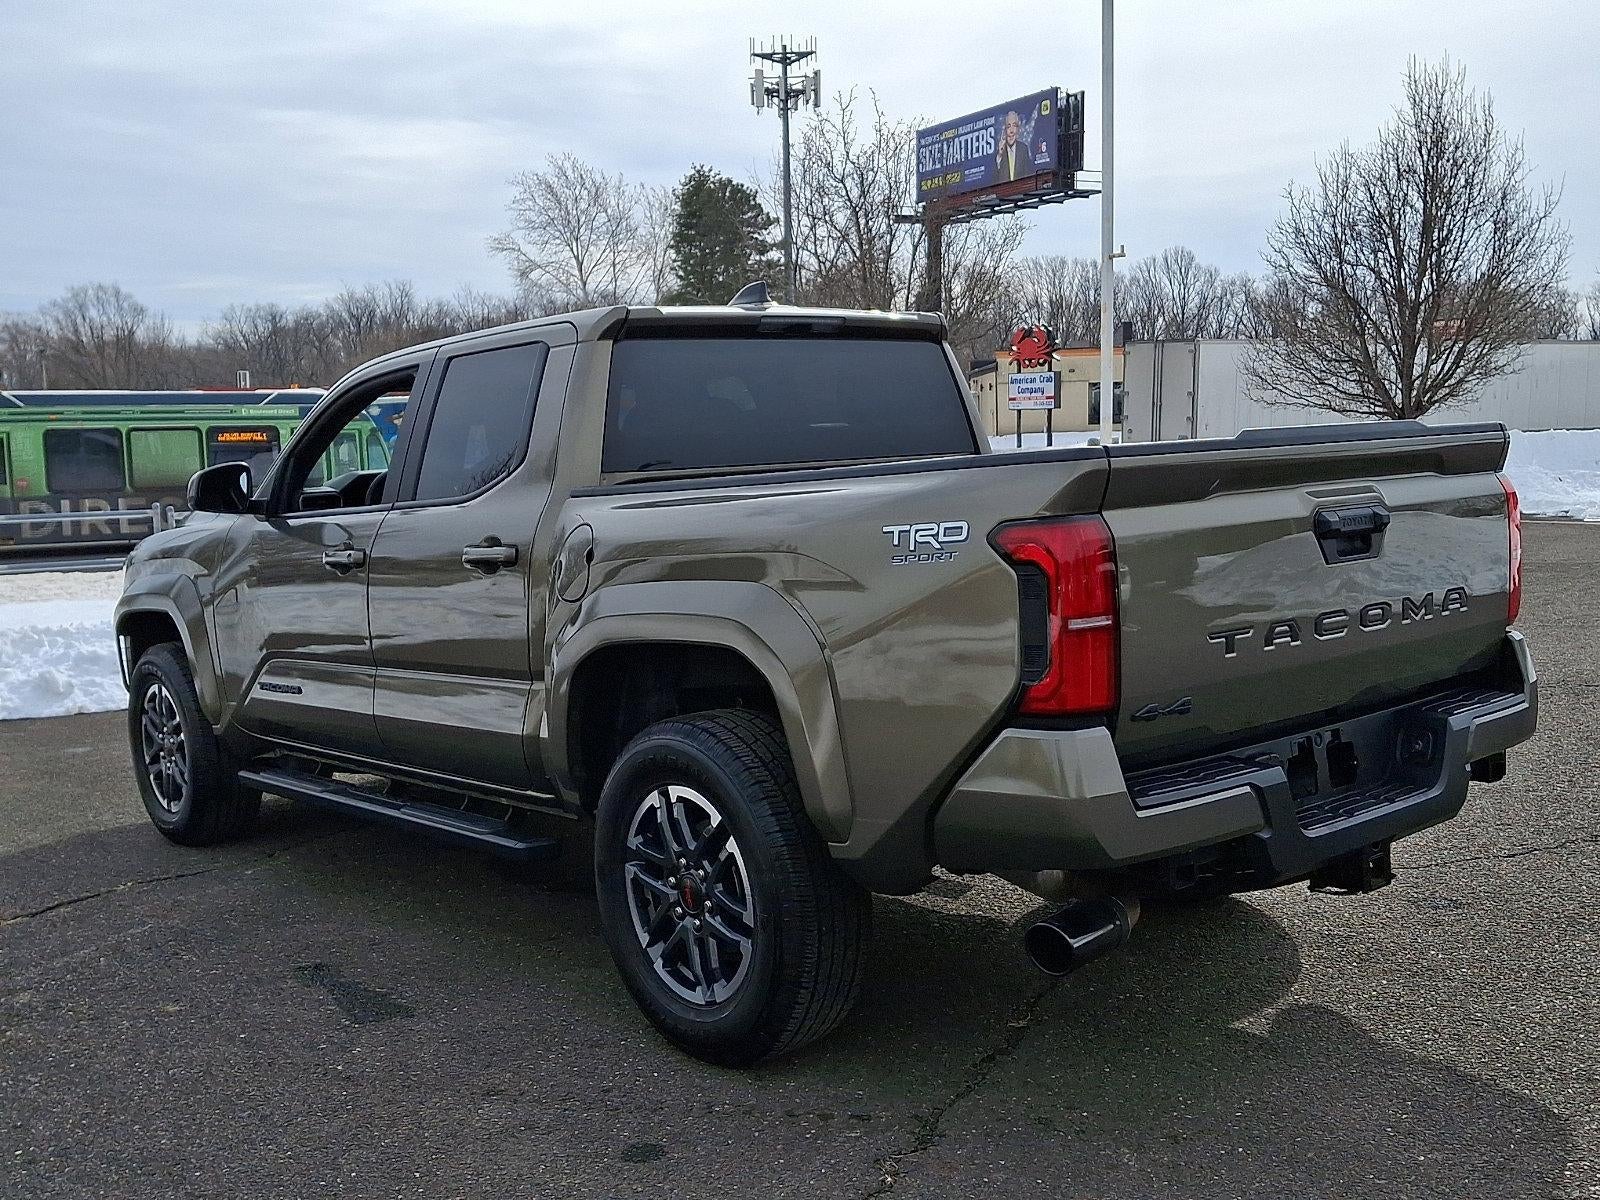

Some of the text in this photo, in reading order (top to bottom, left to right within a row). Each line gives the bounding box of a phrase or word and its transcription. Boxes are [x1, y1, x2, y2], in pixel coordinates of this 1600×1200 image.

[919, 126, 995, 173] SIZE MATTERS
[1010, 374, 1053, 385] American Crab
[1017, 386, 1045, 395] Company
[1341, 512, 1374, 528] TOYOTA
[882, 520, 970, 552] TRD
[891, 551, 959, 565] SPORT
[1206, 586, 1470, 658] TACOMA
[259, 682, 302, 695] ACOMA
